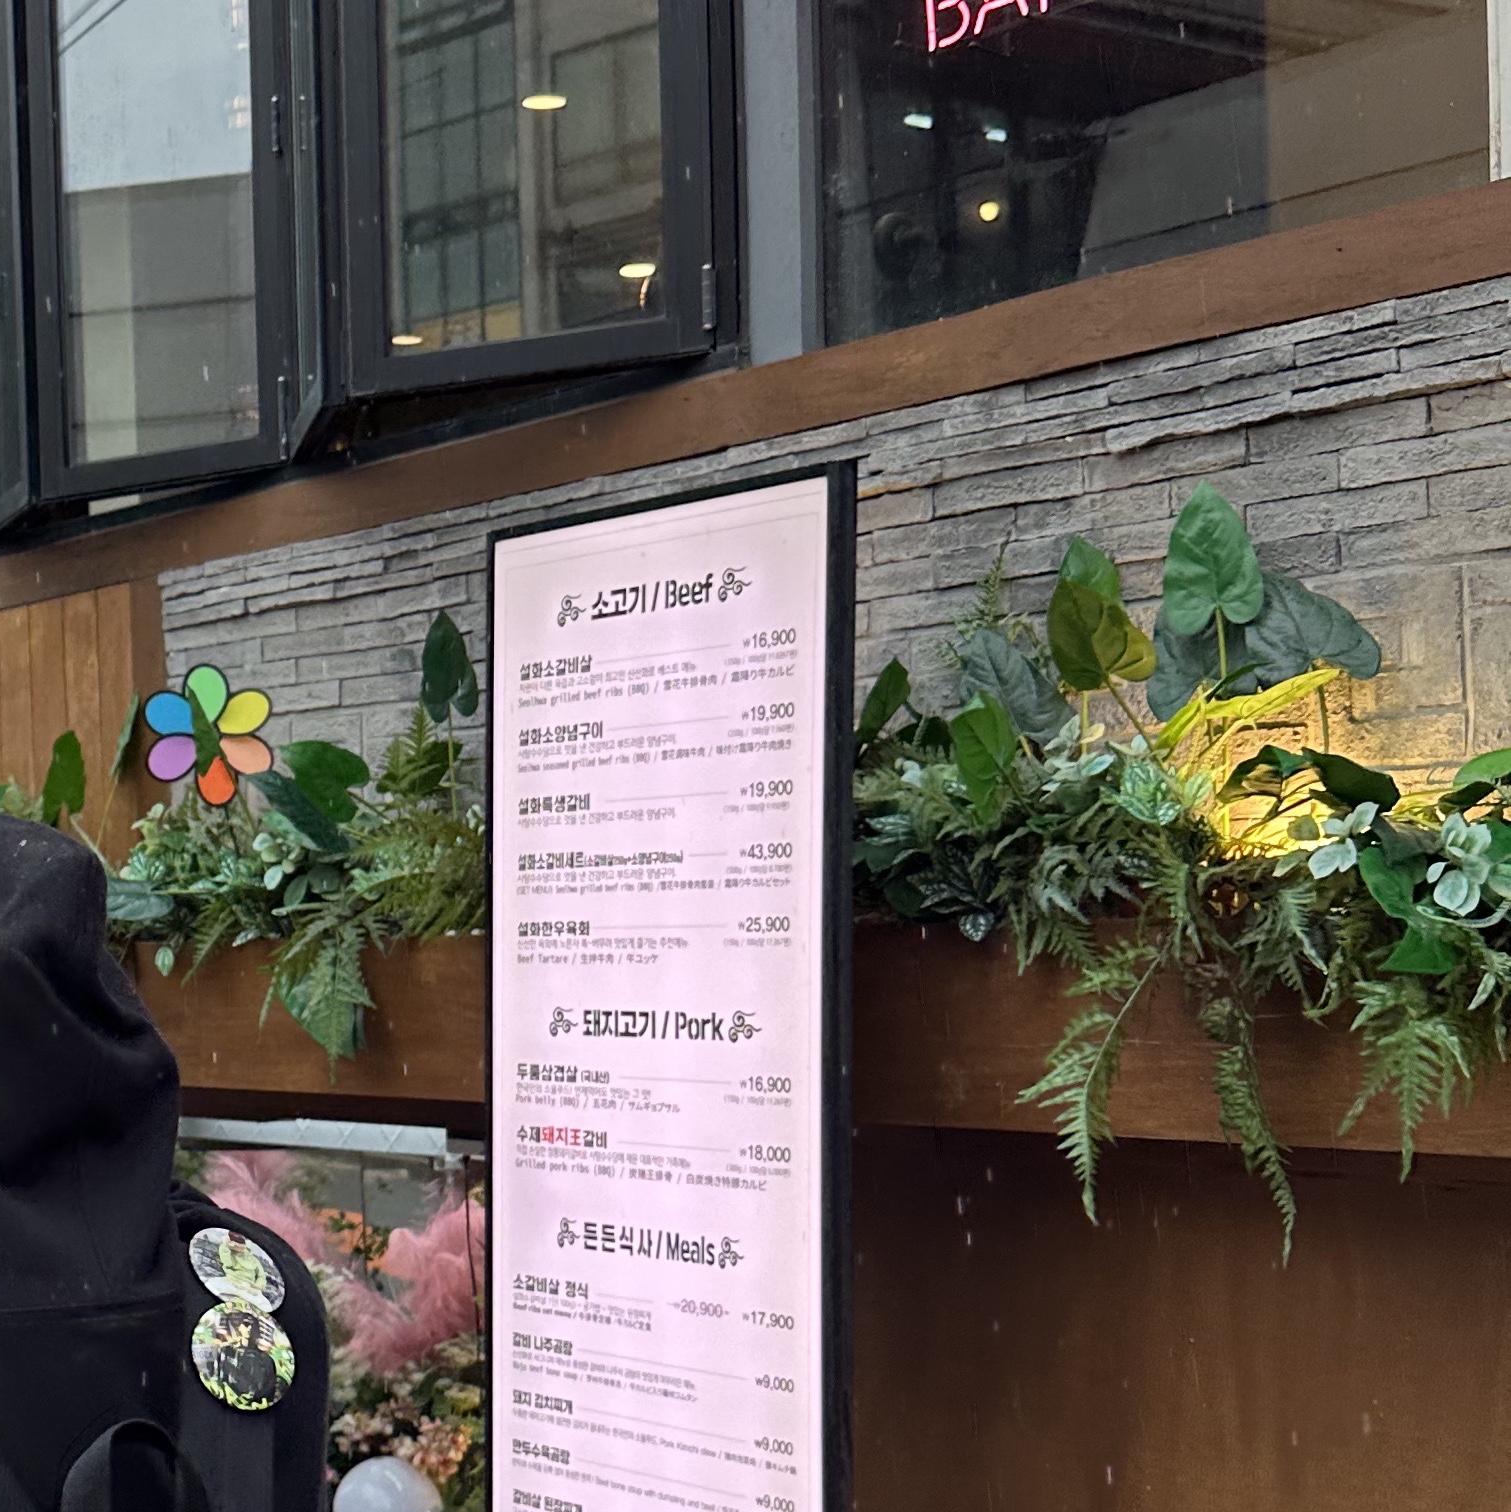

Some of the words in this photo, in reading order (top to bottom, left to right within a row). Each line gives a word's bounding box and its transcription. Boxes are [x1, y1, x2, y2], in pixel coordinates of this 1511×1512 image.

[591, 582, 646, 621] 소고기
[651, 581, 660, 612] /
[664, 573, 714, 609] Beef
[742, 626, 796, 652] ₩16,900
[519, 653, 592, 681] 설화소갈비살
[741, 700, 794, 724] ₩19,900
[518, 720, 602, 746] 설화소양념구이
[740, 778, 792, 800] ₩19,900
[518, 792, 590, 814] 설화특생갈비
[739, 841, 792, 861] ₩43,900
[517, 920, 589, 936] 설화한우육회
[737, 915, 790, 934] ₩25,900
[517, 953, 534, 965] Beef
[537, 953, 568, 965] Tartare
[583, 1009, 656, 1039] 돼지고기
[661, 1011, 670, 1040] /
[675, 1012, 724, 1041] Pork
[739, 1074, 791, 1094] ₩16,900
[739, 1142, 791, 1164] ₩18,000
[515, 1156, 545, 1171] Grilled
[549, 1159, 567, 1173] pork
[571, 1161, 588, 1175] ribs
[583, 1222, 652, 1259] 든든식사
[666, 1232, 715, 1266] Meals
[513, 1272, 559, 1295] 소갈비살
[565, 1279, 588, 1299] 정식
[512, 1331, 531, 1349] 갈비
[755, 1374, 794, 1393] ₩9,000
[754, 1436, 793, 1456] ₩9,000
